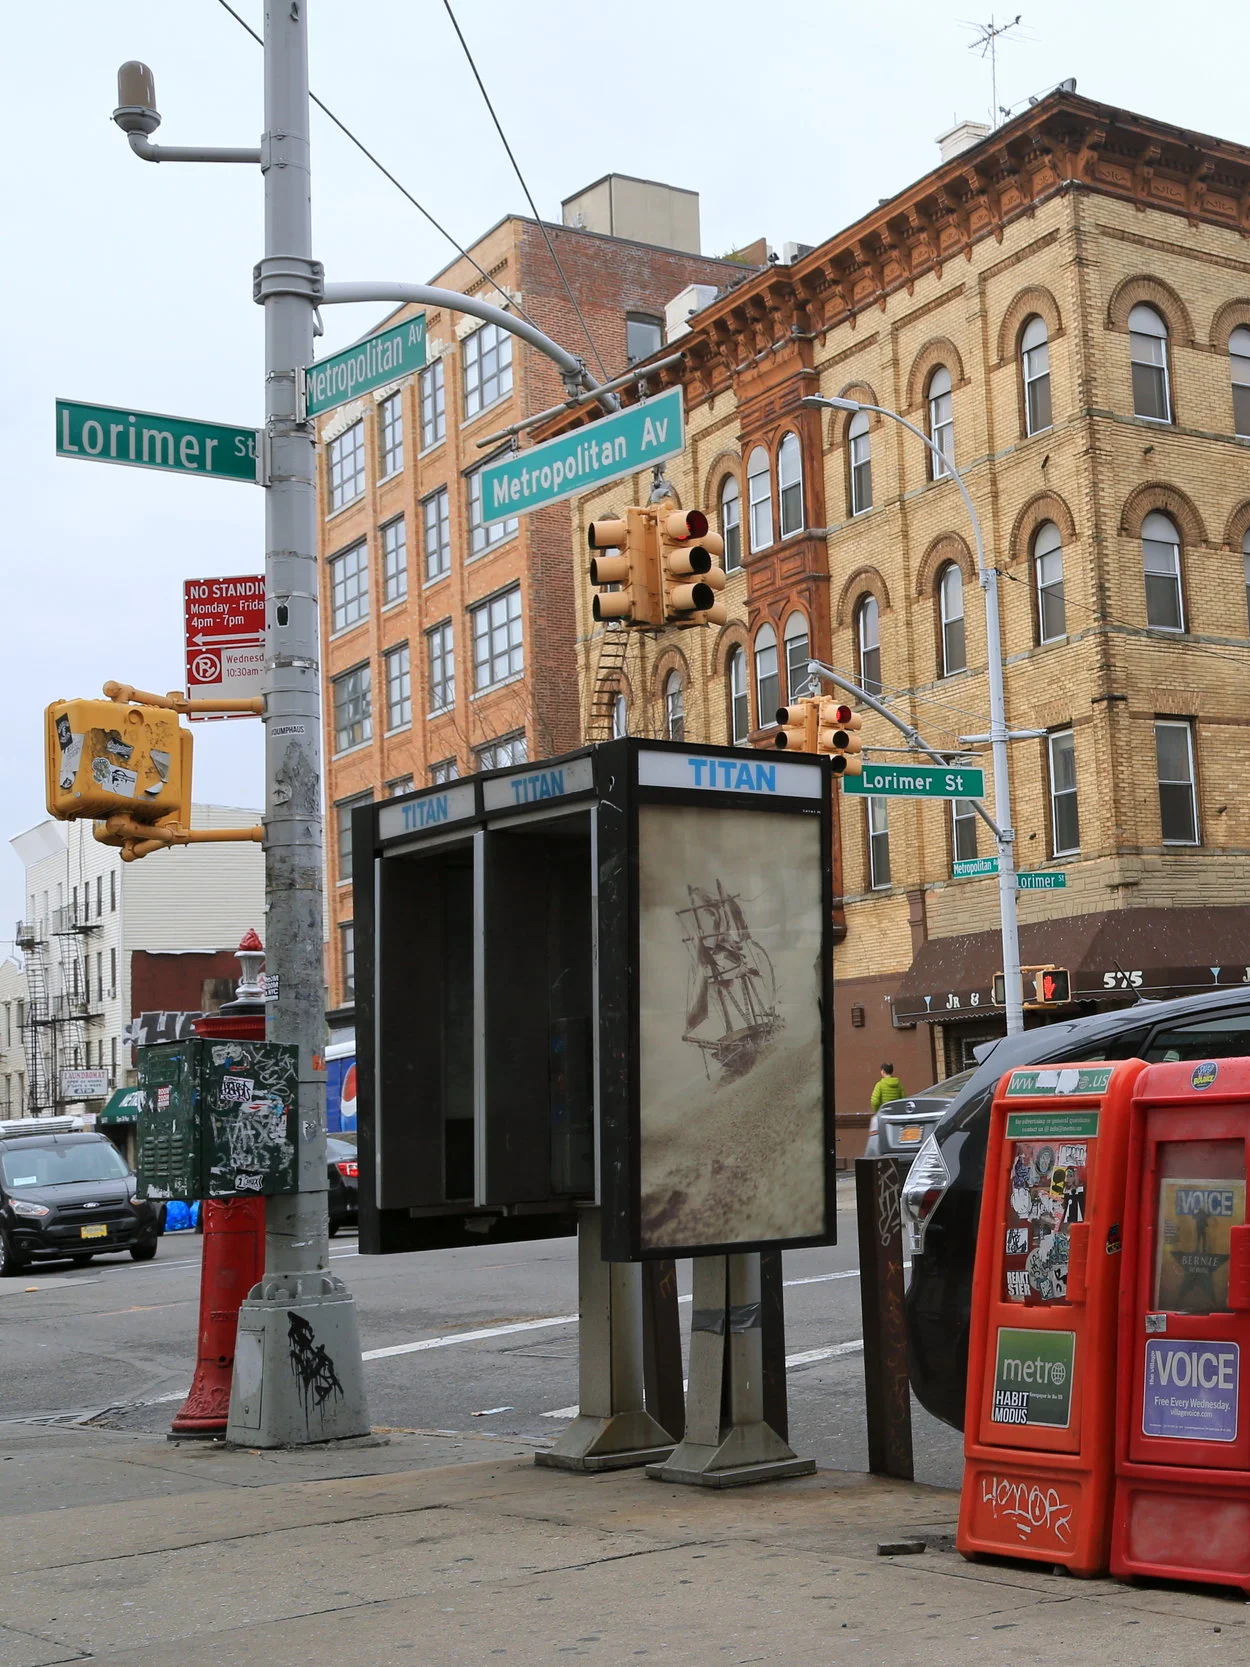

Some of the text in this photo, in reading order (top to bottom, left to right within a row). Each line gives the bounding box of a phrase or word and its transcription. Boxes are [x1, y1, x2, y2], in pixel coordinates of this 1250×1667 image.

[306, 322, 424, 403] Metropolitan Av
[62, 409, 257, 470] Lorimer St
[492, 416, 668, 508] Metropolitan Av
[190, 582, 265, 599] NO STANDIN
[190, 603, 229, 615] Monday
[239, 600, 265, 611] Frida
[191, 616, 213, 628] 4pm
[223, 615, 244, 627] 7pm
[226, 653, 264, 664] Wednesd
[688, 758, 775, 792] TITAN
[862, 766, 964, 791] Lorimer St
[511, 769, 564, 804] TITAN
[401, 794, 448, 831] TITAN
[953, 858, 992, 876] Metropolitan
[1016, 874, 1065, 888] Lorimer St
[1103, 971, 1144, 988] 575
[970, 992, 979, 1006] &
[1180, 1191, 1232, 1215] VOICE
[1182, 1255, 1220, 1267] BERNIE
[1006, 1271, 1029, 1284] REAKT
[1003, 1356, 1066, 1386] metro
[1155, 1350, 1235, 1390] VOICE
[995, 1390, 1029, 1407] HABIT
[1154, 1396, 1231, 1412] Free Every Wednesday.
[994, 1407, 1028, 1424] MODUS
[1170, 1409, 1213, 1418] villagevoice.com
